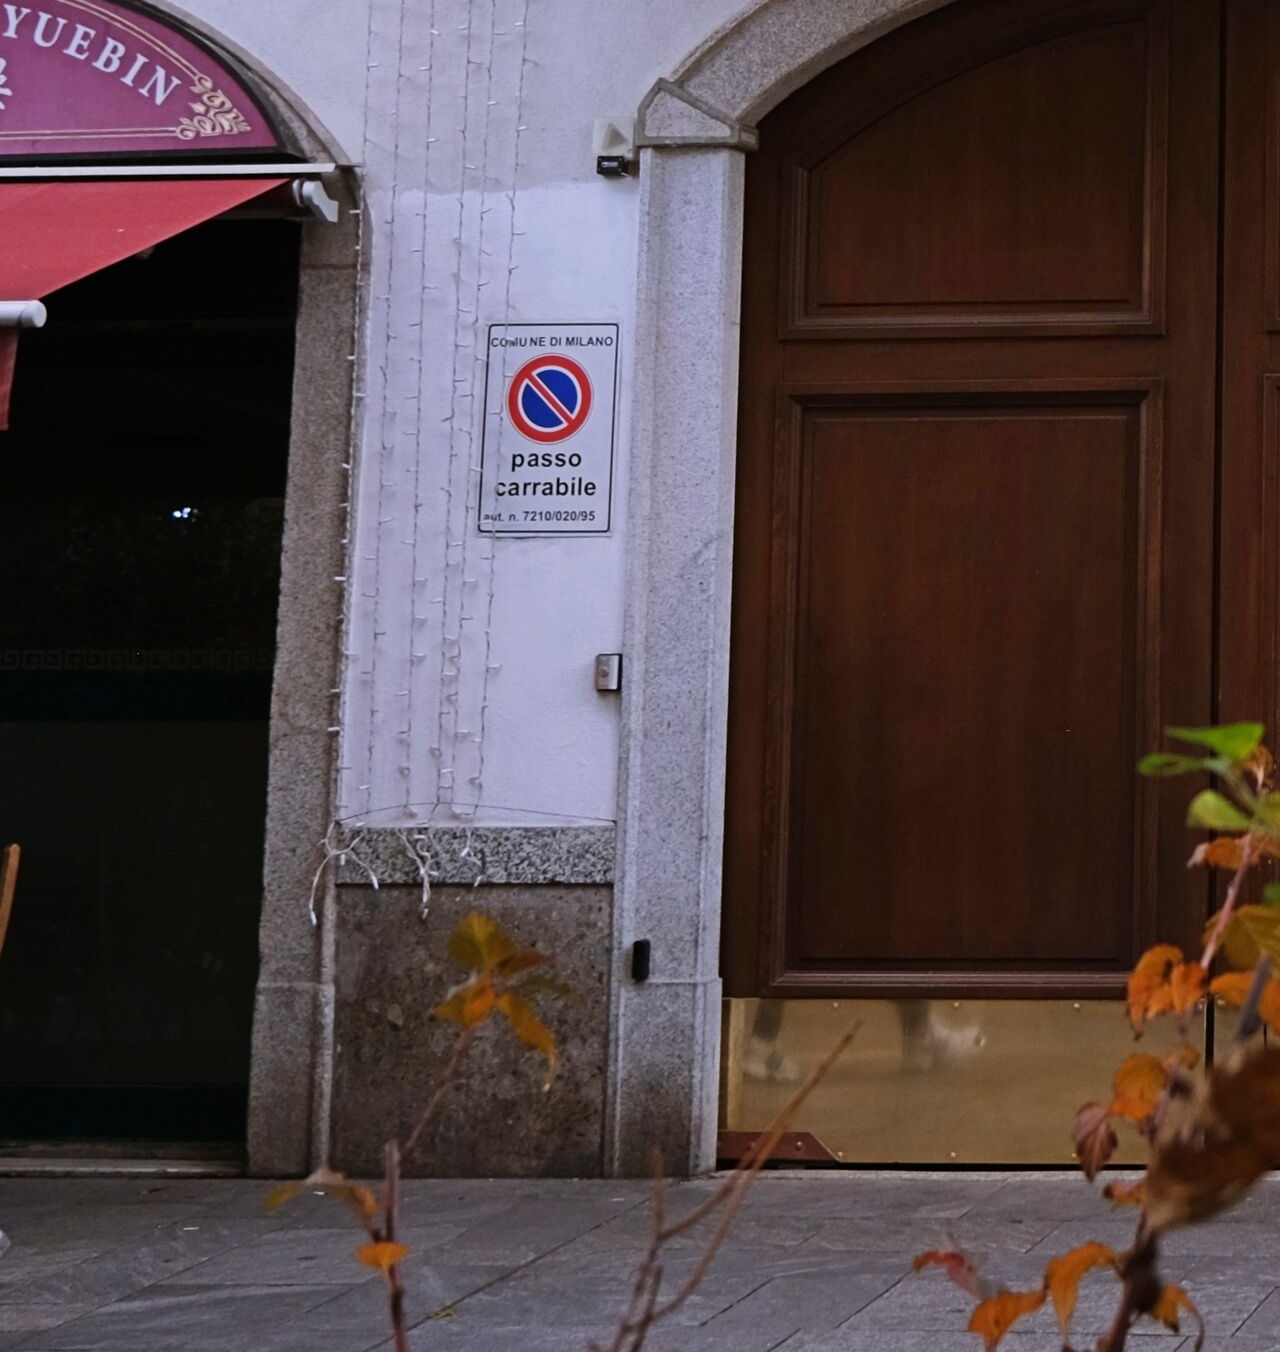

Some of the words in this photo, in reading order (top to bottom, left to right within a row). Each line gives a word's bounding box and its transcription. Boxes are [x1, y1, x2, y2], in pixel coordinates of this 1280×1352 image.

[2, 3, 182, 106] YUEBIN
[491, 336, 546, 348] COMUNE
[549, 336, 562, 347] DI
[565, 336, 614, 347] MILANO
[511, 453, 582, 473] passo
[496, 477, 597, 497] carrabile
[483, 512, 505, 522] aut.
[508, 513, 520, 522] n.
[523, 510, 596, 522] 7210/020/95
